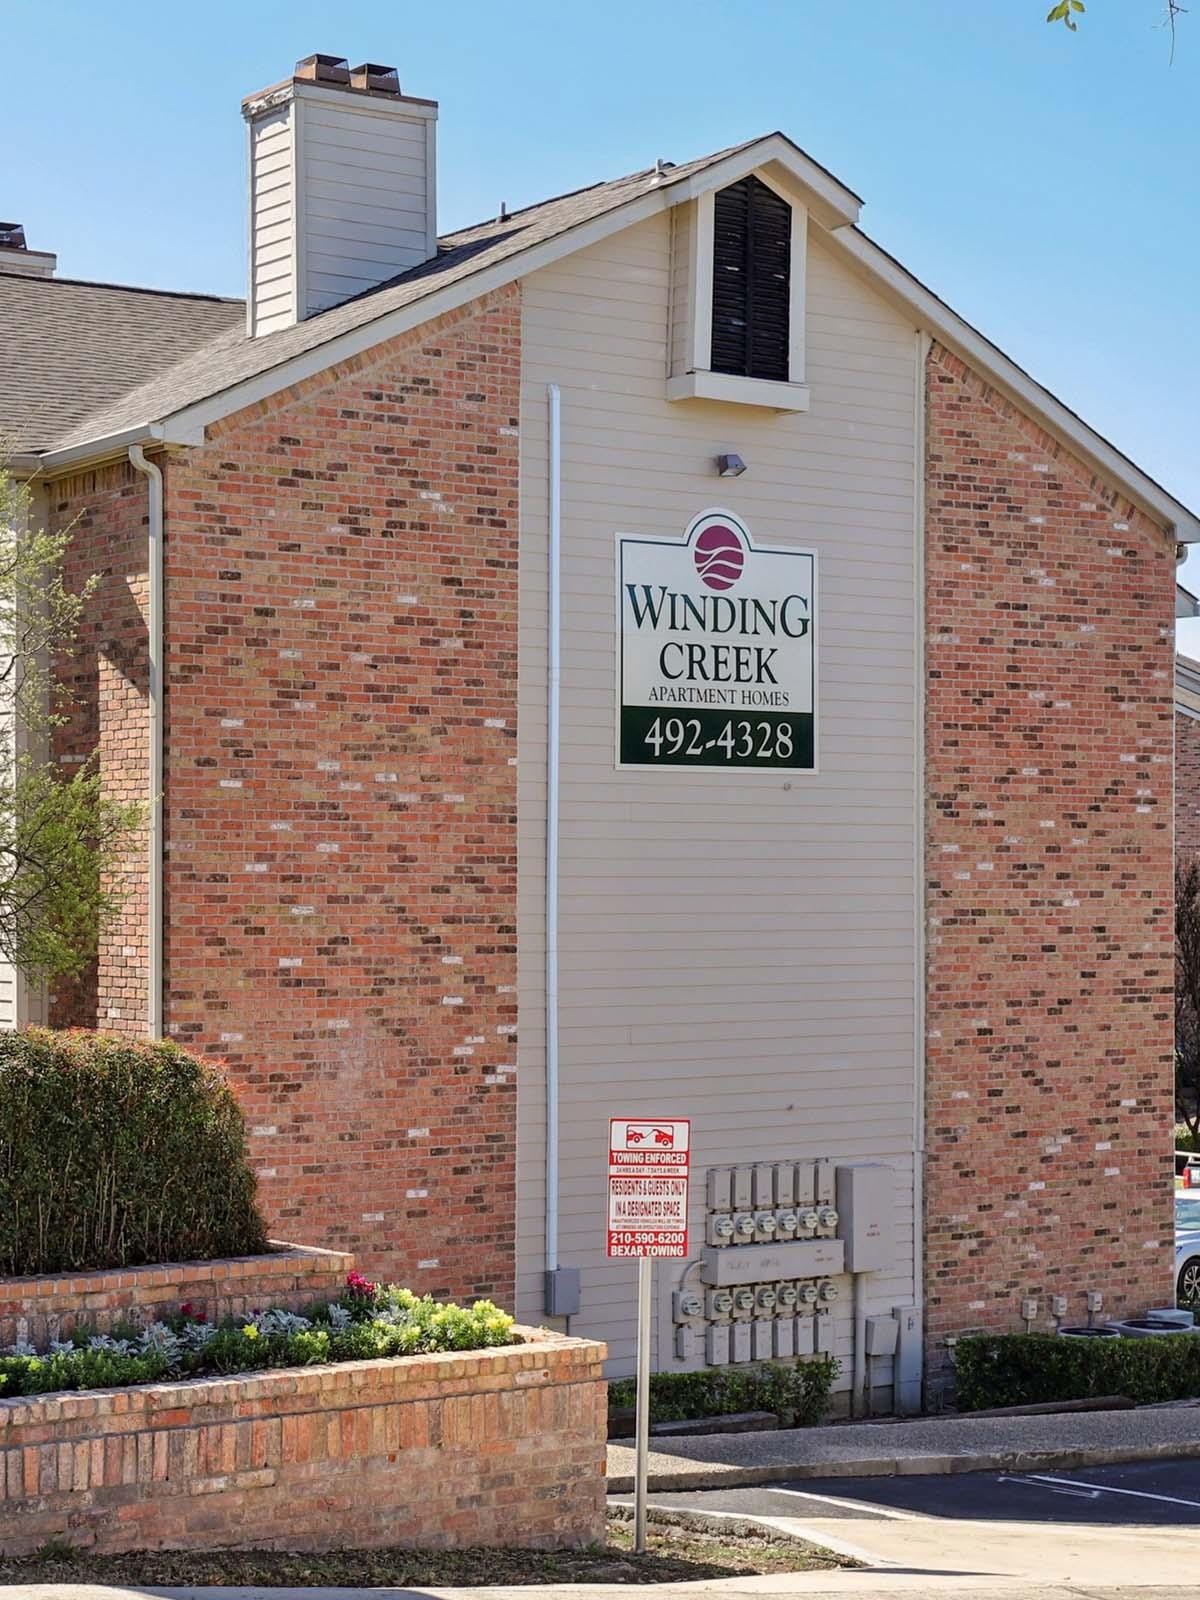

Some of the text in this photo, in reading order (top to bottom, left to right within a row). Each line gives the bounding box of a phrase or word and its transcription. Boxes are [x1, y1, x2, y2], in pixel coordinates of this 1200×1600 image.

[625, 584, 810, 638] WINDING
[659, 642, 778, 684] CREEK
[648, 686, 790, 707] APARTMENT HOMES
[644, 717, 793, 760] 492-4328
[612, 1152, 687, 1164] TOWING ENFORCED
[612, 1180, 642, 1196] RESIDENTS
[648, 1180, 669, 1196] GUESTS
[671, 1180, 685, 1196] ONLY
[628, 1201, 661, 1216] DESIGNATED
[663, 1201, 680, 1216] SPACE
[611, 1232, 684, 1244] 210-590-6200
[611, 1245, 684, 1257] BEXAR TOWING
